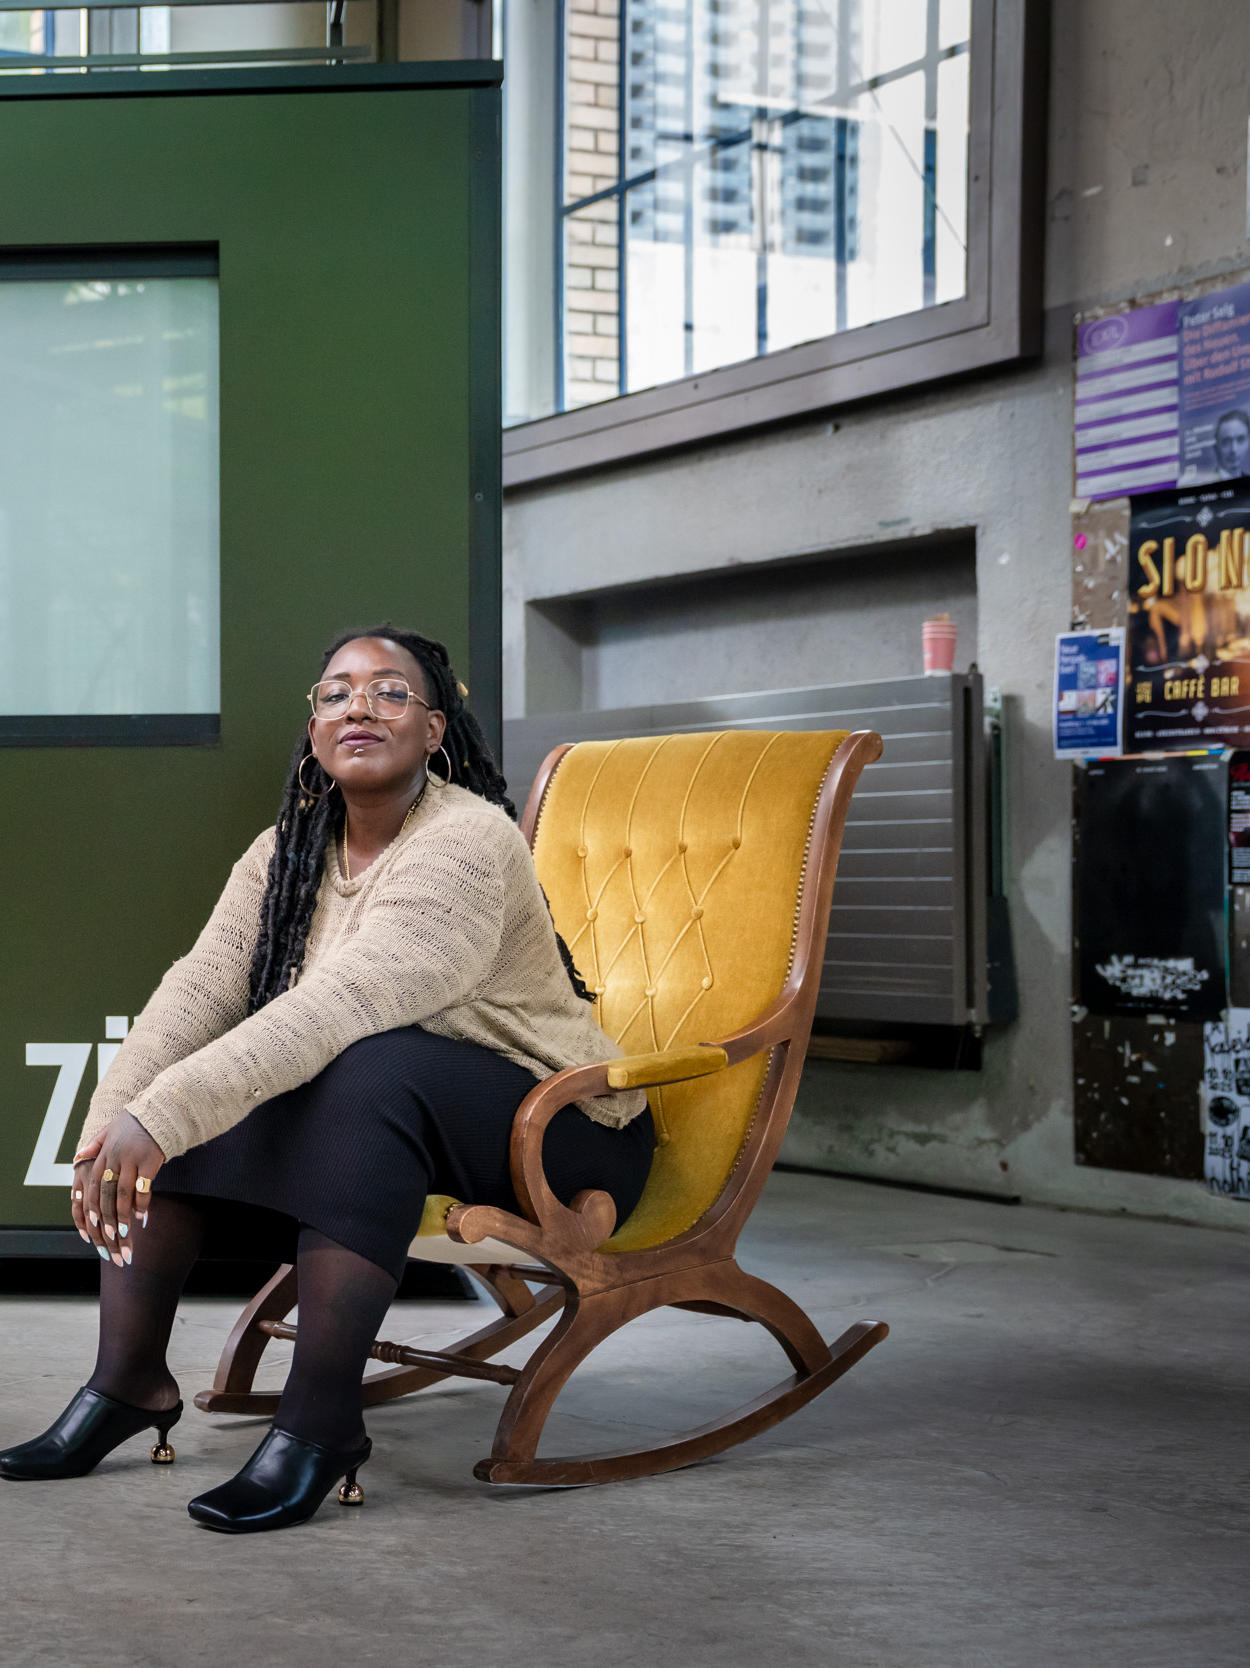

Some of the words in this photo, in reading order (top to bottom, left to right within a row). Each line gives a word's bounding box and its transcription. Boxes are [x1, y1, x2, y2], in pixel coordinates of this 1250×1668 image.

[1163, 674, 1206, 701] CAFFÈ
[1210, 675, 1240, 698] BAR
[23, 1016, 140, 1186] Z
